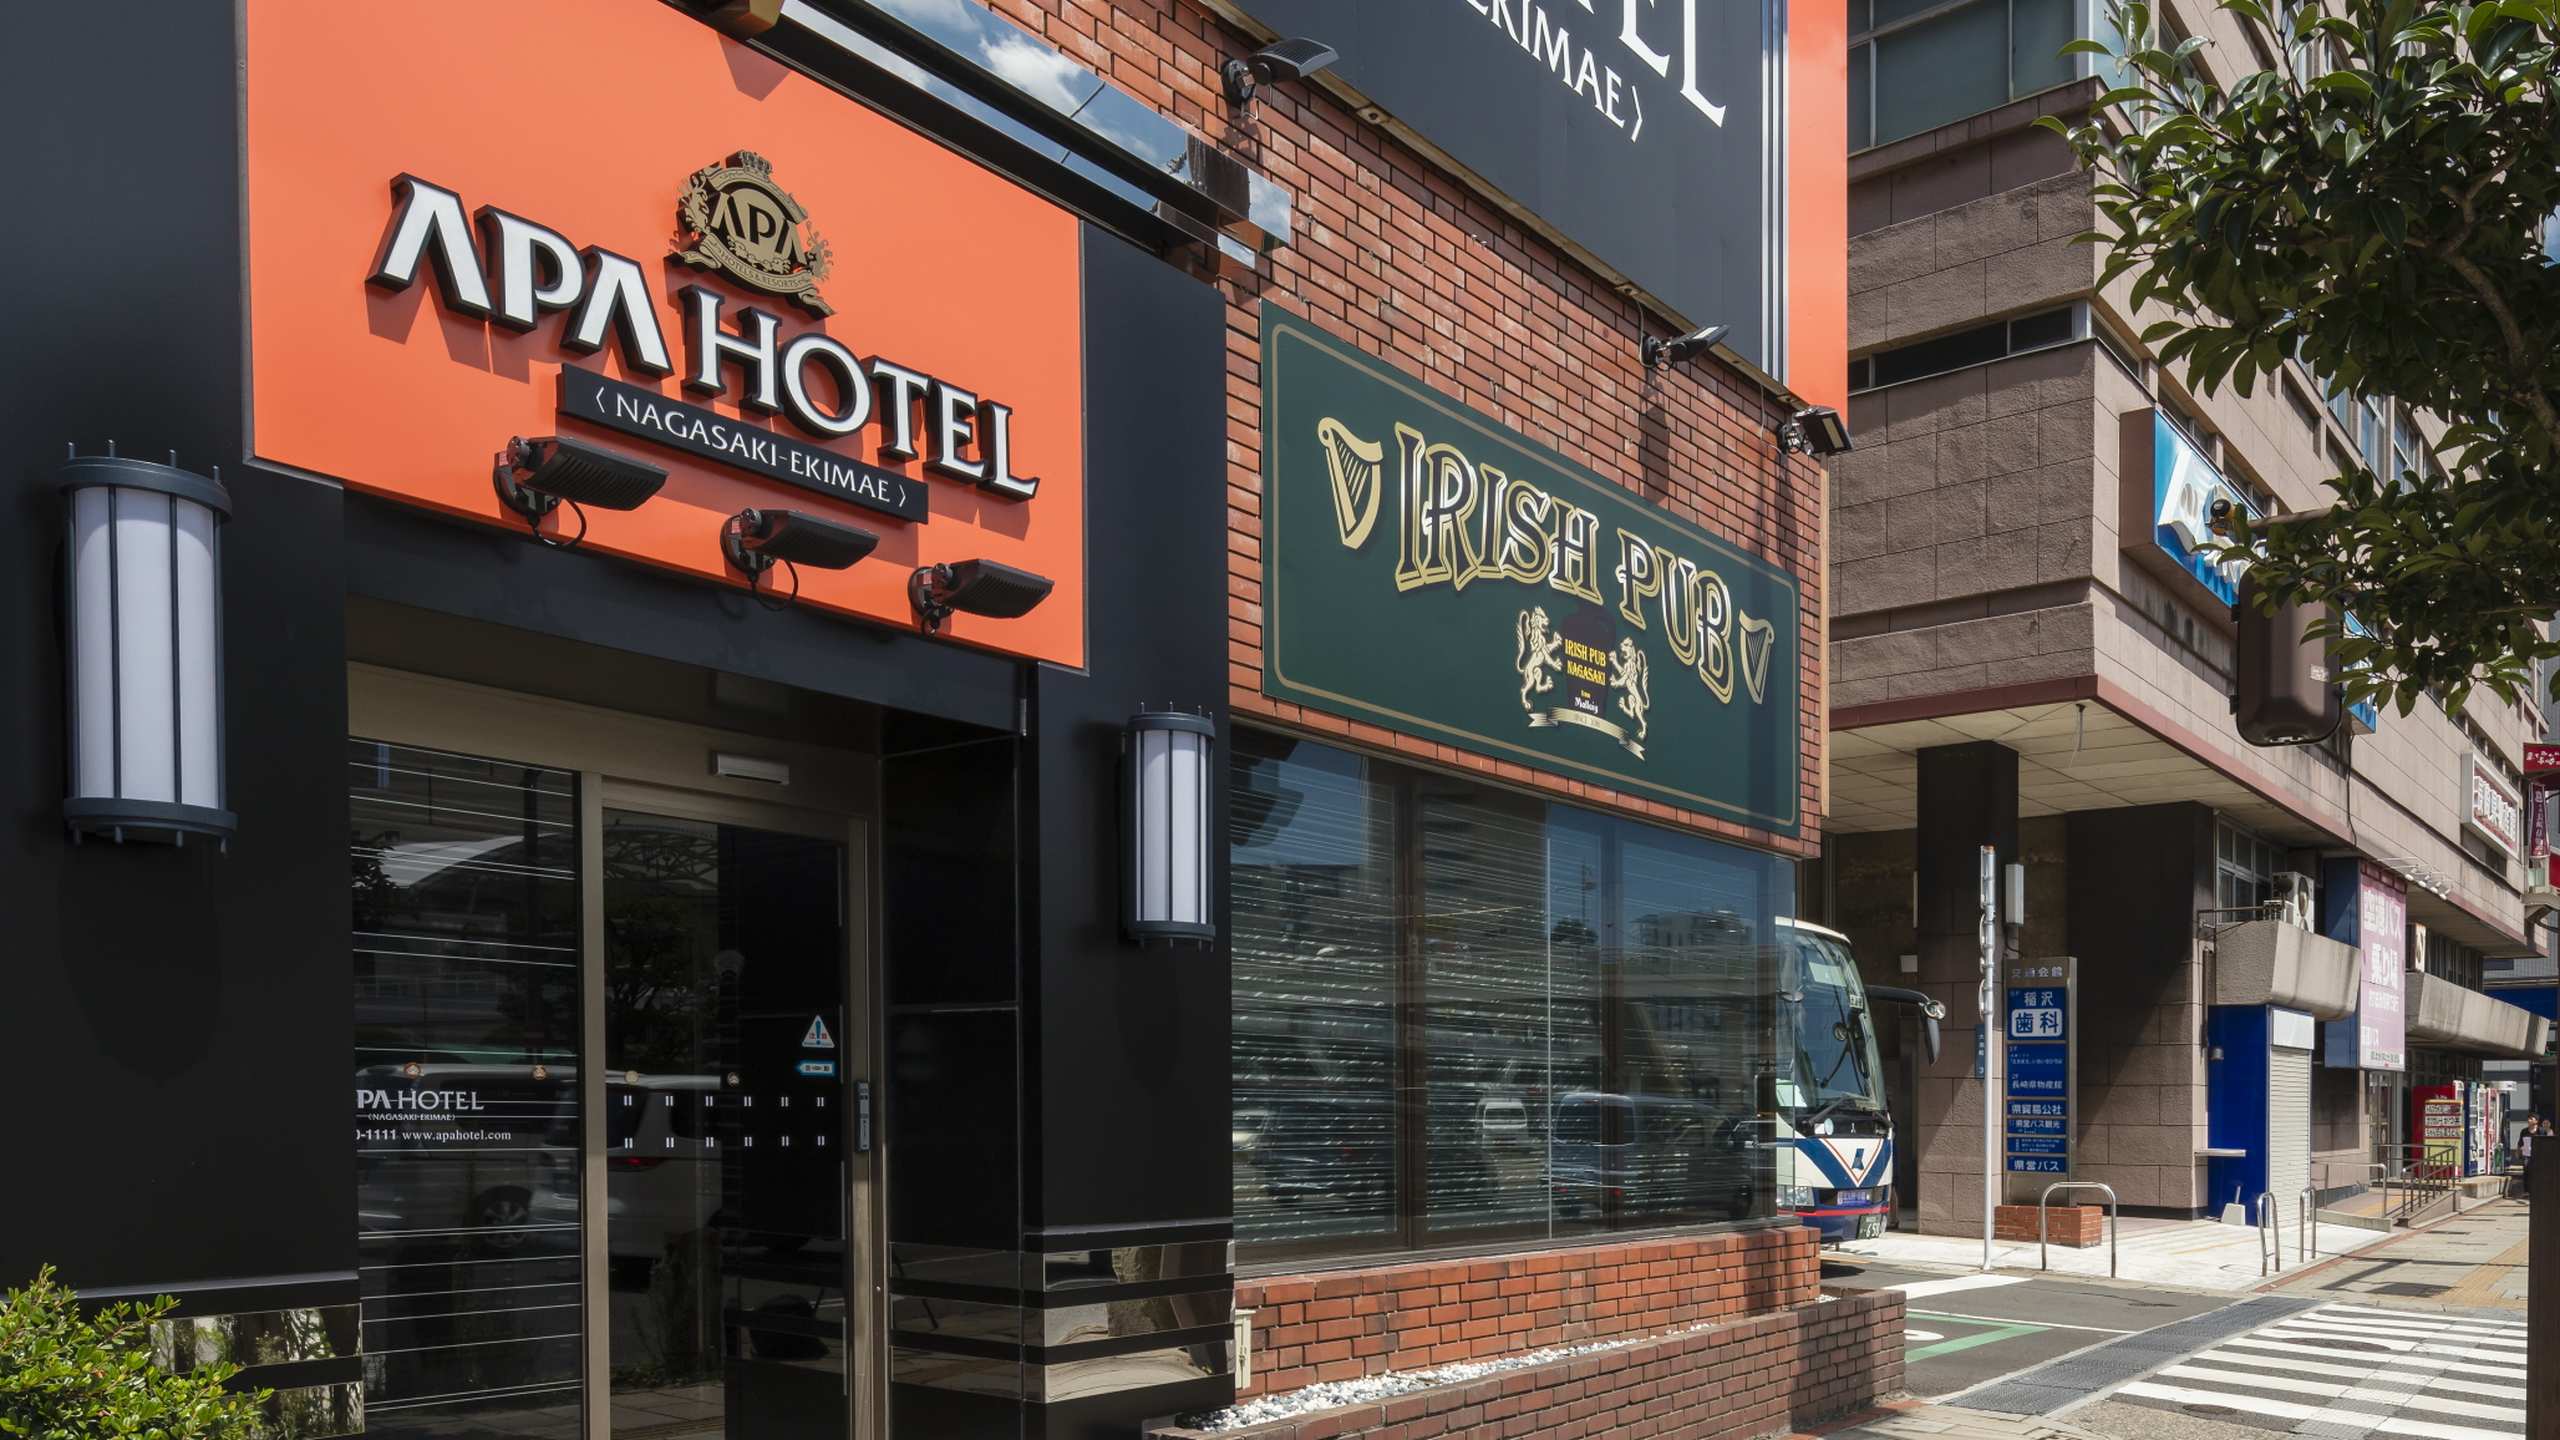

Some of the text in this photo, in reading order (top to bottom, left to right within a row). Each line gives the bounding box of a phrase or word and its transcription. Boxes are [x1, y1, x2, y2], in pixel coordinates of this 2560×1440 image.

[372, 174, 1040, 501] APA HOTEL
[1395, 421, 1735, 704] IRISH PUB
[1564, 638, 1606, 667] IRISH PUB
[1567, 660, 1606, 686] NAGASAKI
[2015, 1010, 2059, 1035] 歯科
[398, 1089, 485, 1110] HOTEL
[402, 1130, 512, 1143] www.apahotel.com
[2014, 1159, 2060, 1171] 県営バス
